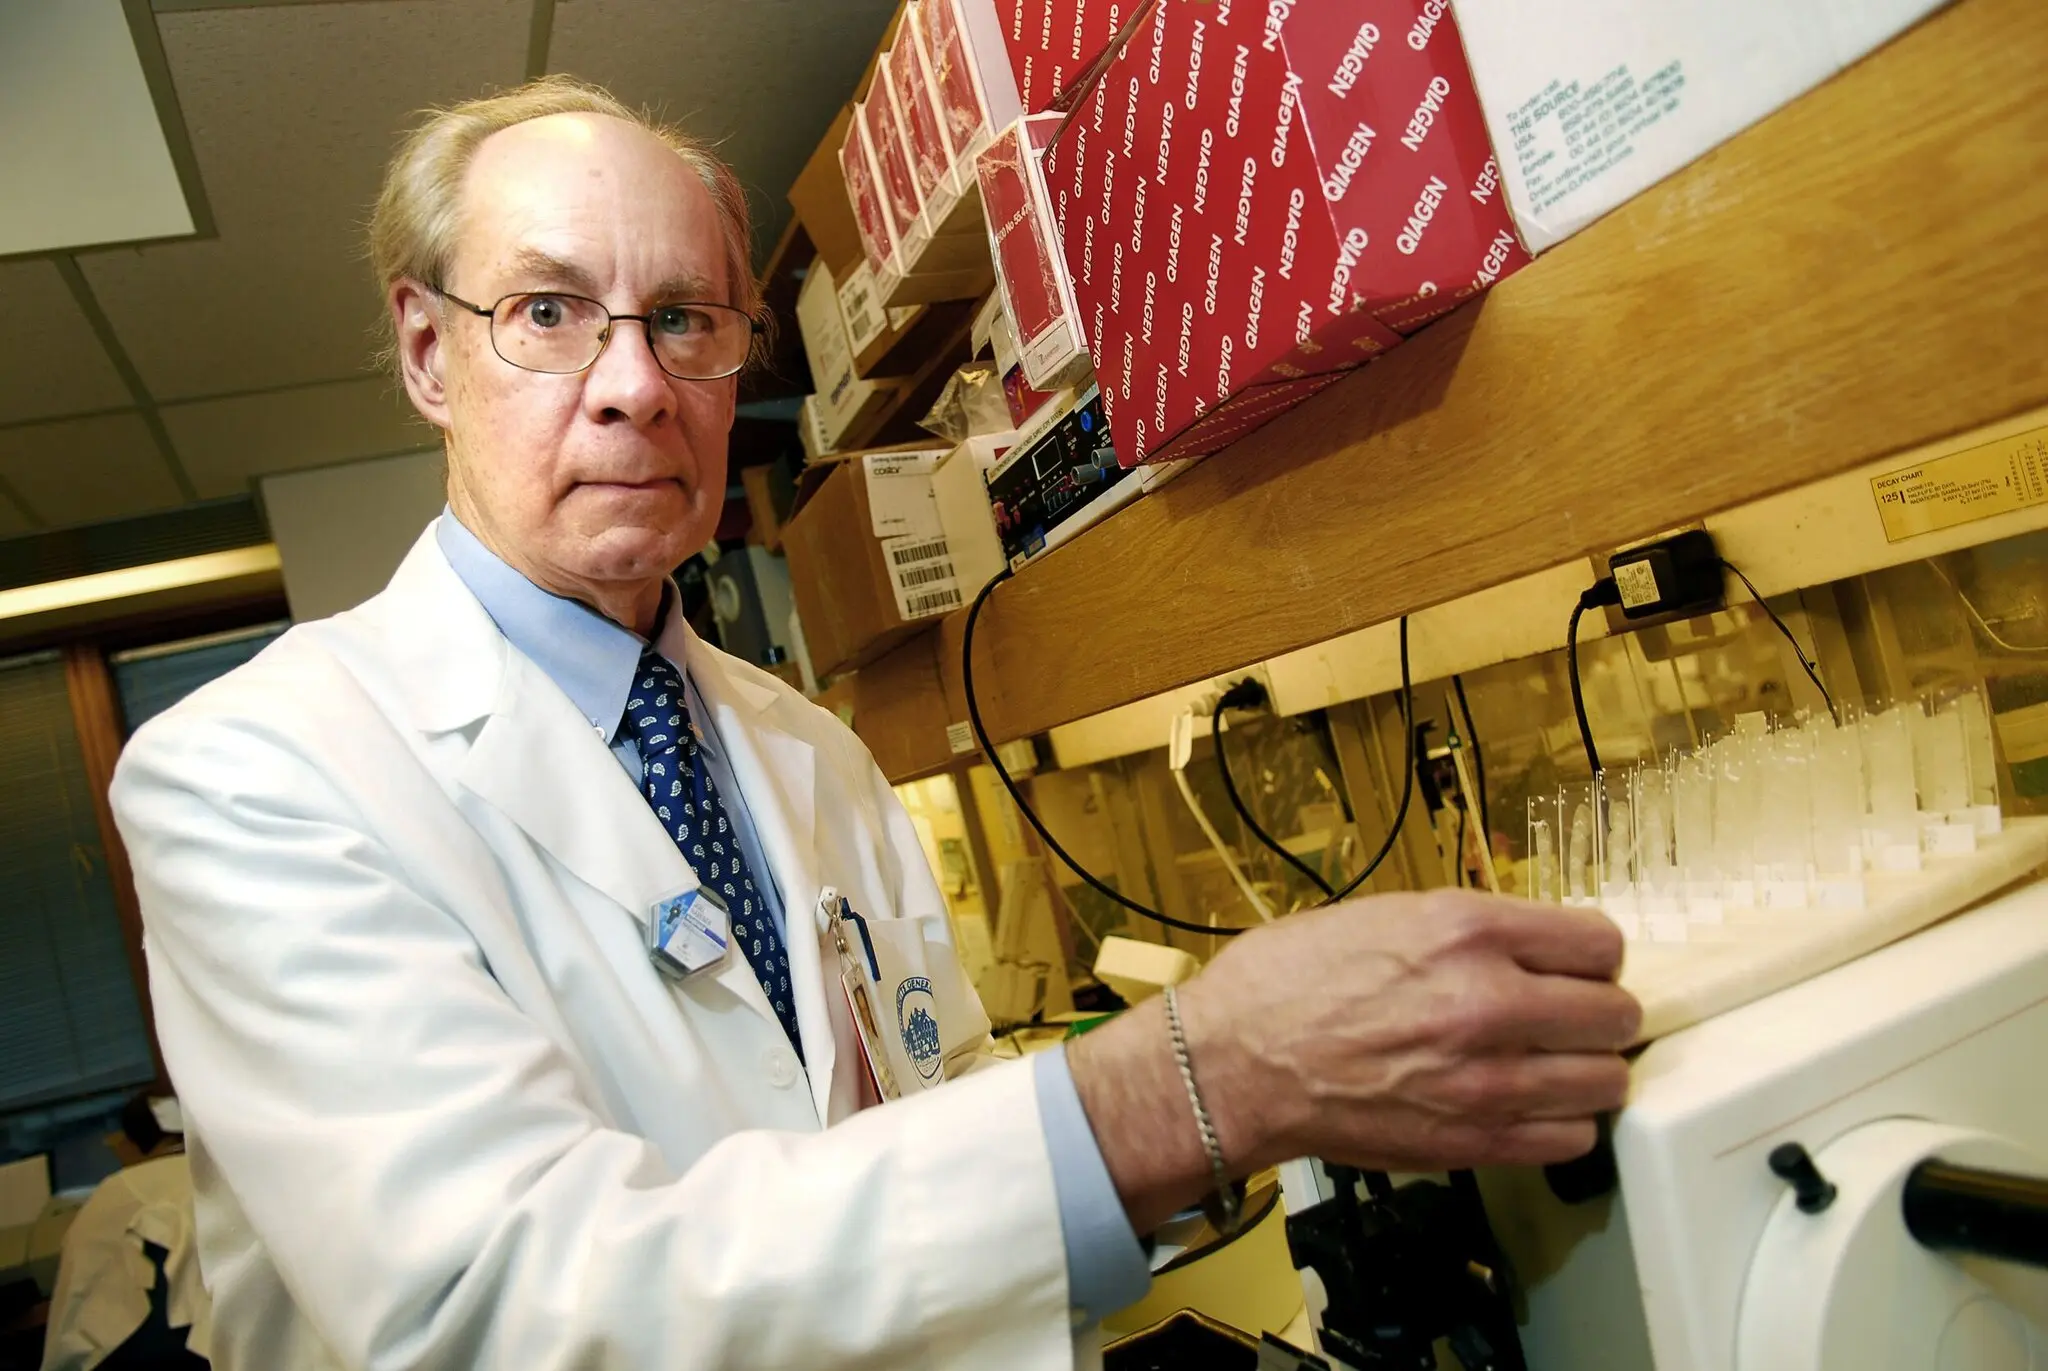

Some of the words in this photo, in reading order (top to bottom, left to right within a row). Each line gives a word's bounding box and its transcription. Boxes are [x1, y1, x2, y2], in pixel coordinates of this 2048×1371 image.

[1013, 0, 1023, 41] AGEN
[1041, 0, 1053, 50] IAGEN
[1071, 0, 1086, 60] QIAGEN
[1108, 4, 1119, 42] QIA
[1149, 0, 1167, 84] QIAGEN
[1262, 0, 1296, 52] GEN
[1407, 0, 1448, 51] QIAGE
[1052, 65, 1062, 97] GEN
[1185, 20, 1205, 110] QIAGEN
[1226, 44, 1249, 138] QIAGEN
[1327, 22, 1380, 99] QIAGEN
[1093, 72, 1108, 133] AGEN
[1123, 77, 1138, 158] QIAGEN
[1271, 71, 1303, 168] QIAGEN
[1400, 76, 1450, 152] QIAGEN
[1510, 118, 1532, 138] THE
[1533, 79, 1580, 121] SOURCE
[1519, 95, 1542, 114] order
[1048, 143, 1057, 173] QIA
[1074, 125, 1087, 198] QIAGEN
[1156, 102, 1174, 185] QIAGEN
[1193, 128, 1213, 215] QIAGEN
[1323, 122, 1376, 202] QIAGEN
[1101, 150, 1115, 225] QIAGEN
[1131, 176, 1147, 253] QIAGEN
[1234, 157, 1256, 246] QIAGEN
[1396, 175, 1448, 255] QIAGEN
[1470, 155, 1499, 205] GEN
[1528, 179, 1553, 202] Order
[1555, 163, 1582, 186] online
[1058, 190, 1067, 245] QIAG
[1082, 215, 1094, 285] QIAGEN
[1166, 204, 1183, 283] QIAGEN
[1278, 188, 1304, 280] QIAGEN
[1110, 243, 1122, 314] QIAGEN
[1204, 233, 1223, 315] QIAGEN
[1327, 227, 1368, 316] QIAGEN
[1093, 302, 1104, 369] QIAGEN
[1142, 271, 1156, 345] QIAGEN
[1178, 302, 1193, 377] QIAGEN
[1245, 265, 1266, 350] QIAGEN
[1295, 300, 1313, 346] GEN
[1122, 332, 1133, 400] QIAGEN
[1155, 363, 1168, 432] QIAGEN
[1217, 335, 1233, 402] QIAGE
[1135, 419, 1146, 461] QIAG
[1877, 476, 1900, 489] DECAY
[1901, 470, 1924, 482] CHART
[1881, 491, 1899, 504] 125
